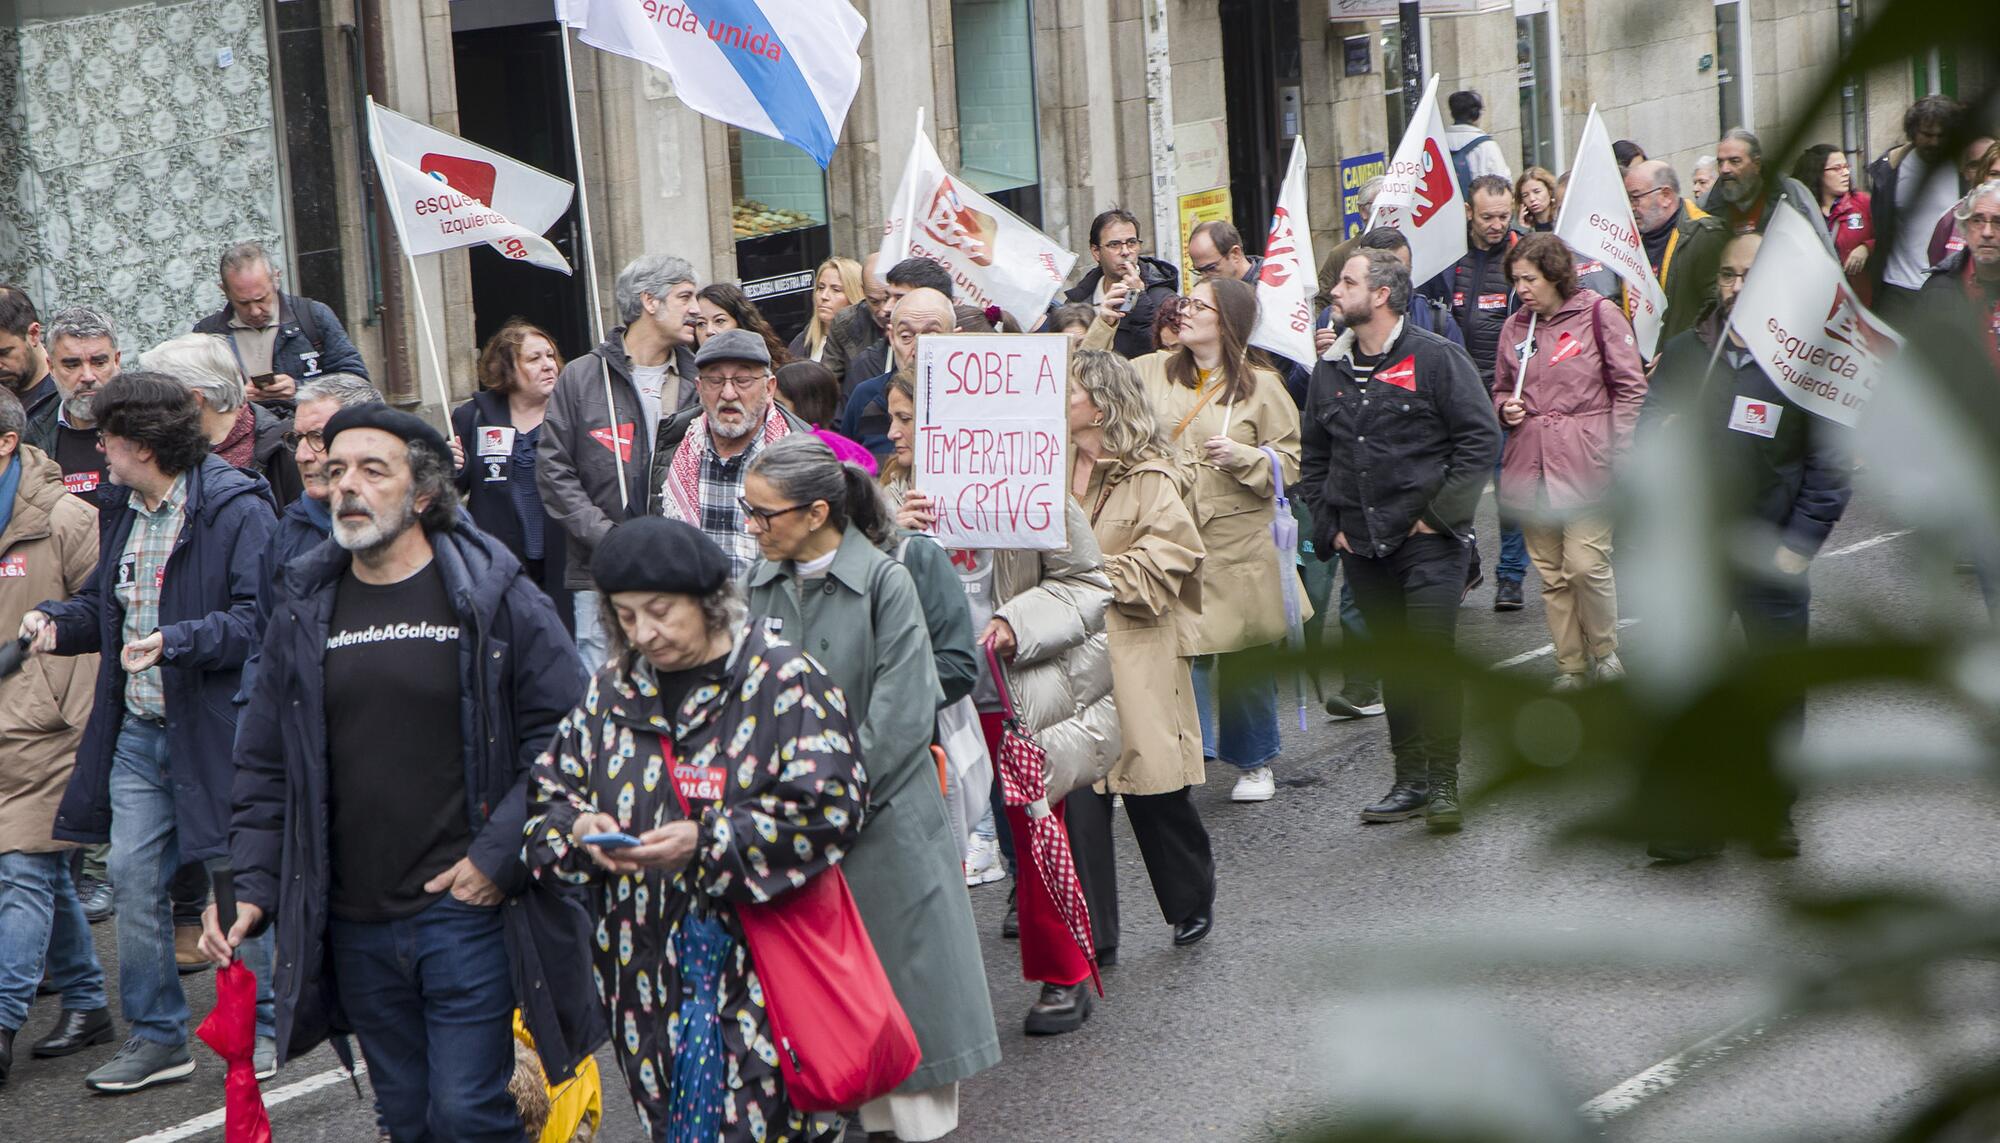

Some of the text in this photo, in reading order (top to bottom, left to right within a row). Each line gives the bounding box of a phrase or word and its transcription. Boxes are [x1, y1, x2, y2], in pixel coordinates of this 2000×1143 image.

[707, 19, 782, 62] unida
[945, 351, 1057, 395] SOBE A
[1767, 317, 1859, 380] esquerda
[1772, 350, 1840, 401] izquierda
[920, 426, 1060, 475] TEMPERATURA
[957, 478, 1053, 533] CRTVG
